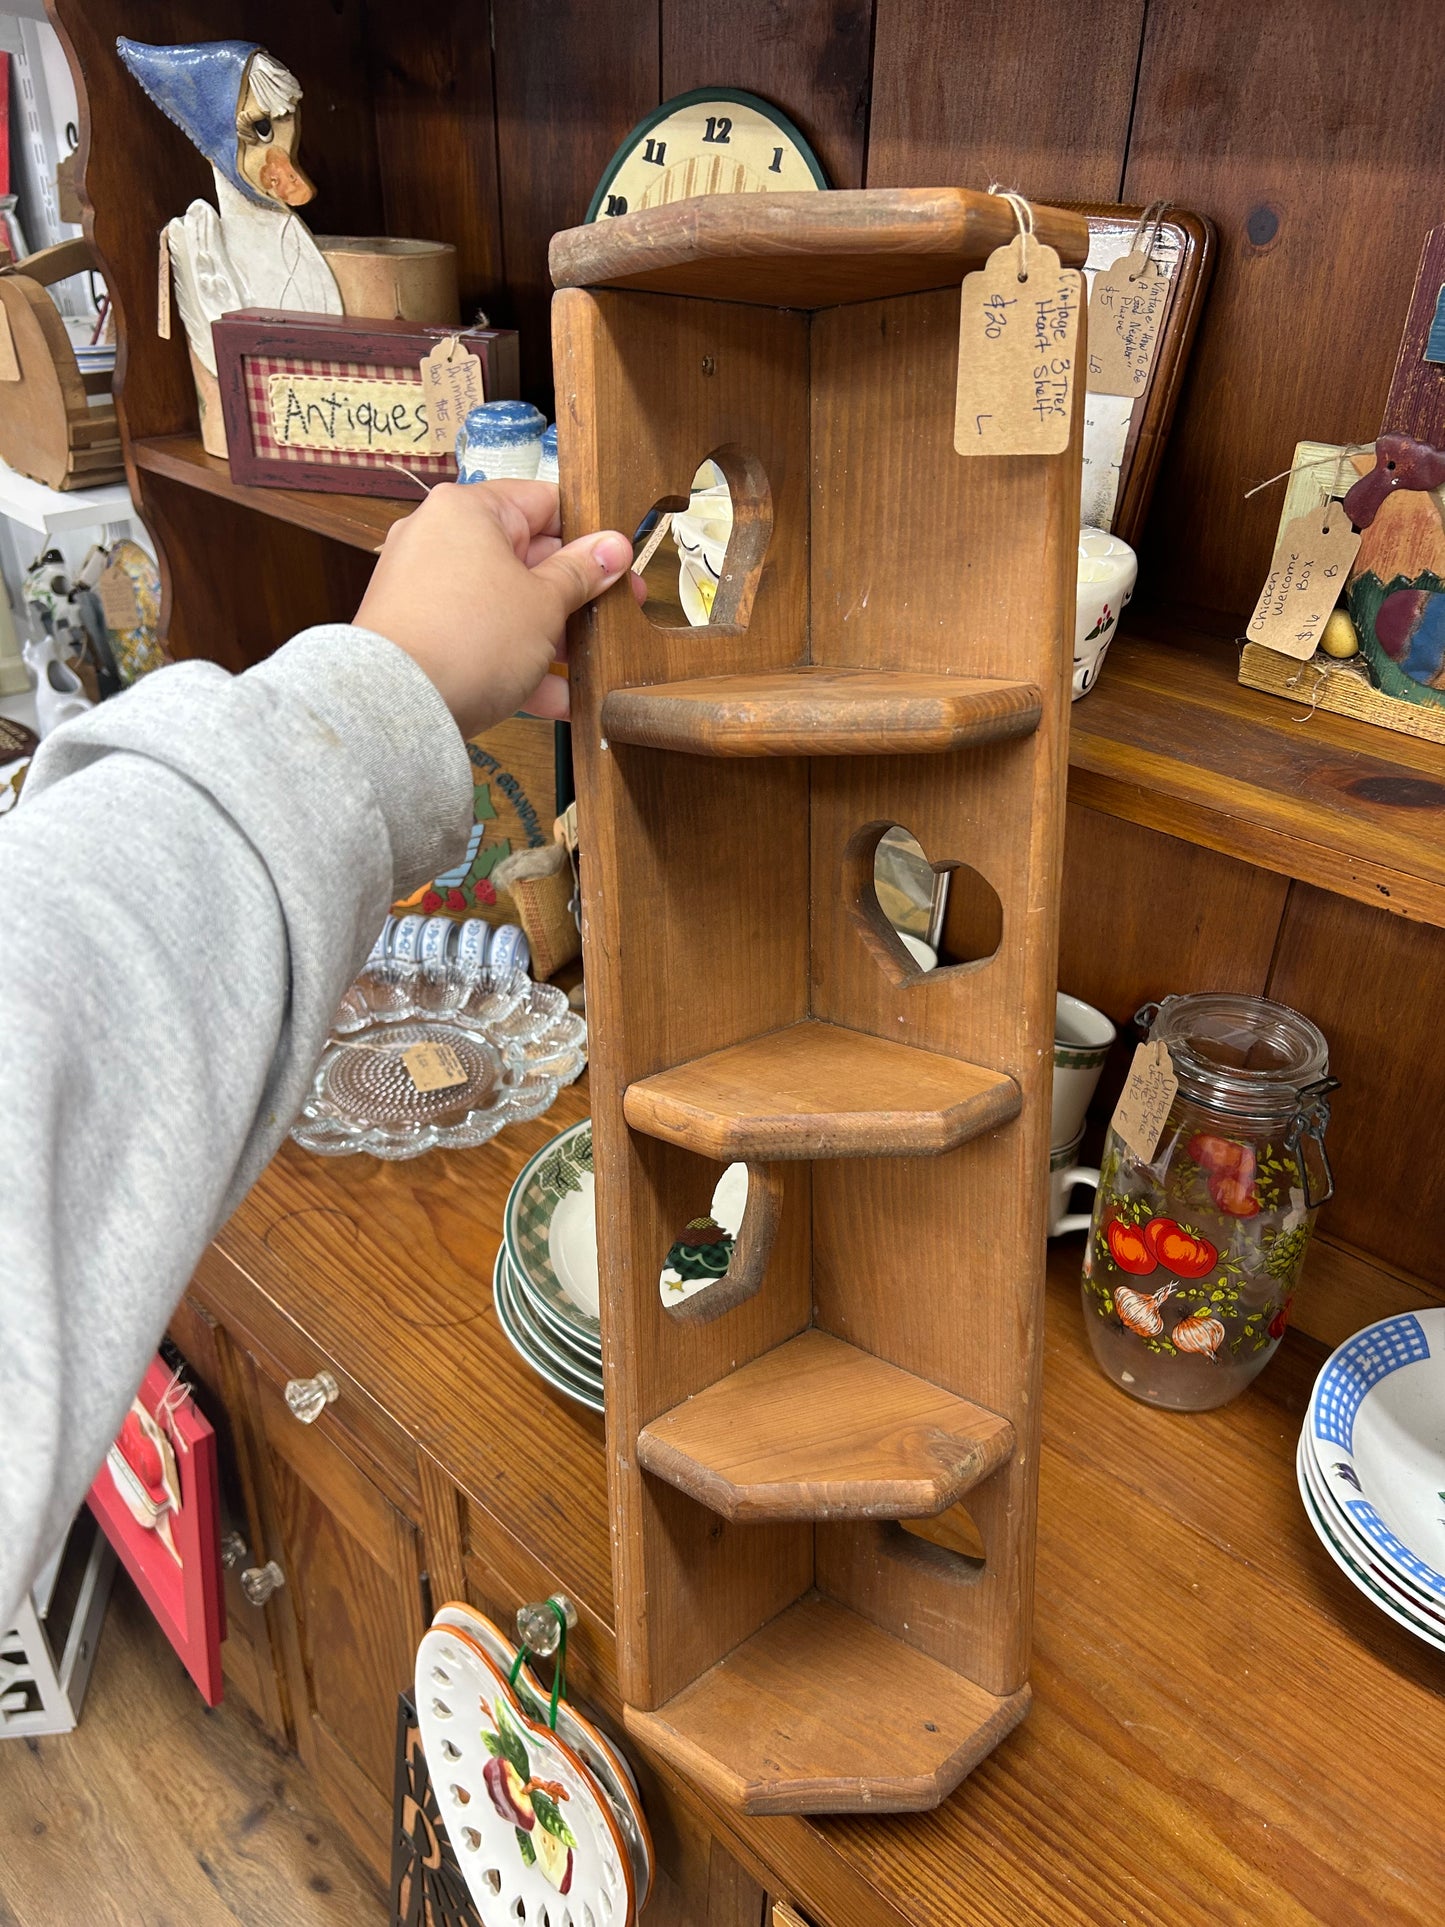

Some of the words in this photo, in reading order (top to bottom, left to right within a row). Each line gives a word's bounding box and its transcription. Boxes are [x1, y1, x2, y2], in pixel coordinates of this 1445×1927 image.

[703, 116, 732, 143] 12
[642, 138, 667, 166] 11
[768, 147, 784, 173] 1
[605, 194, 628, 217] 10
[1098, 285, 1120, 312] $5
[1138, 281, 1149, 292] A
[983, 294, 1018, 340] $20
[1050, 274, 1077, 342] Vintage
[1143, 281, 1165, 324] Vintage
[1034, 299, 1056, 353] Heart
[1050, 358, 1070, 375] 3
[1132, 368, 1147, 384] Be
[1032, 364, 1054, 422] Shelf
[284, 388, 429, 444] Antiques
[1272, 552, 1300, 616] Welcome
[1295, 560, 1315, 591] Box
[1252, 571, 1280, 631] Chicken
[1295, 613, 1321, 642] $16
